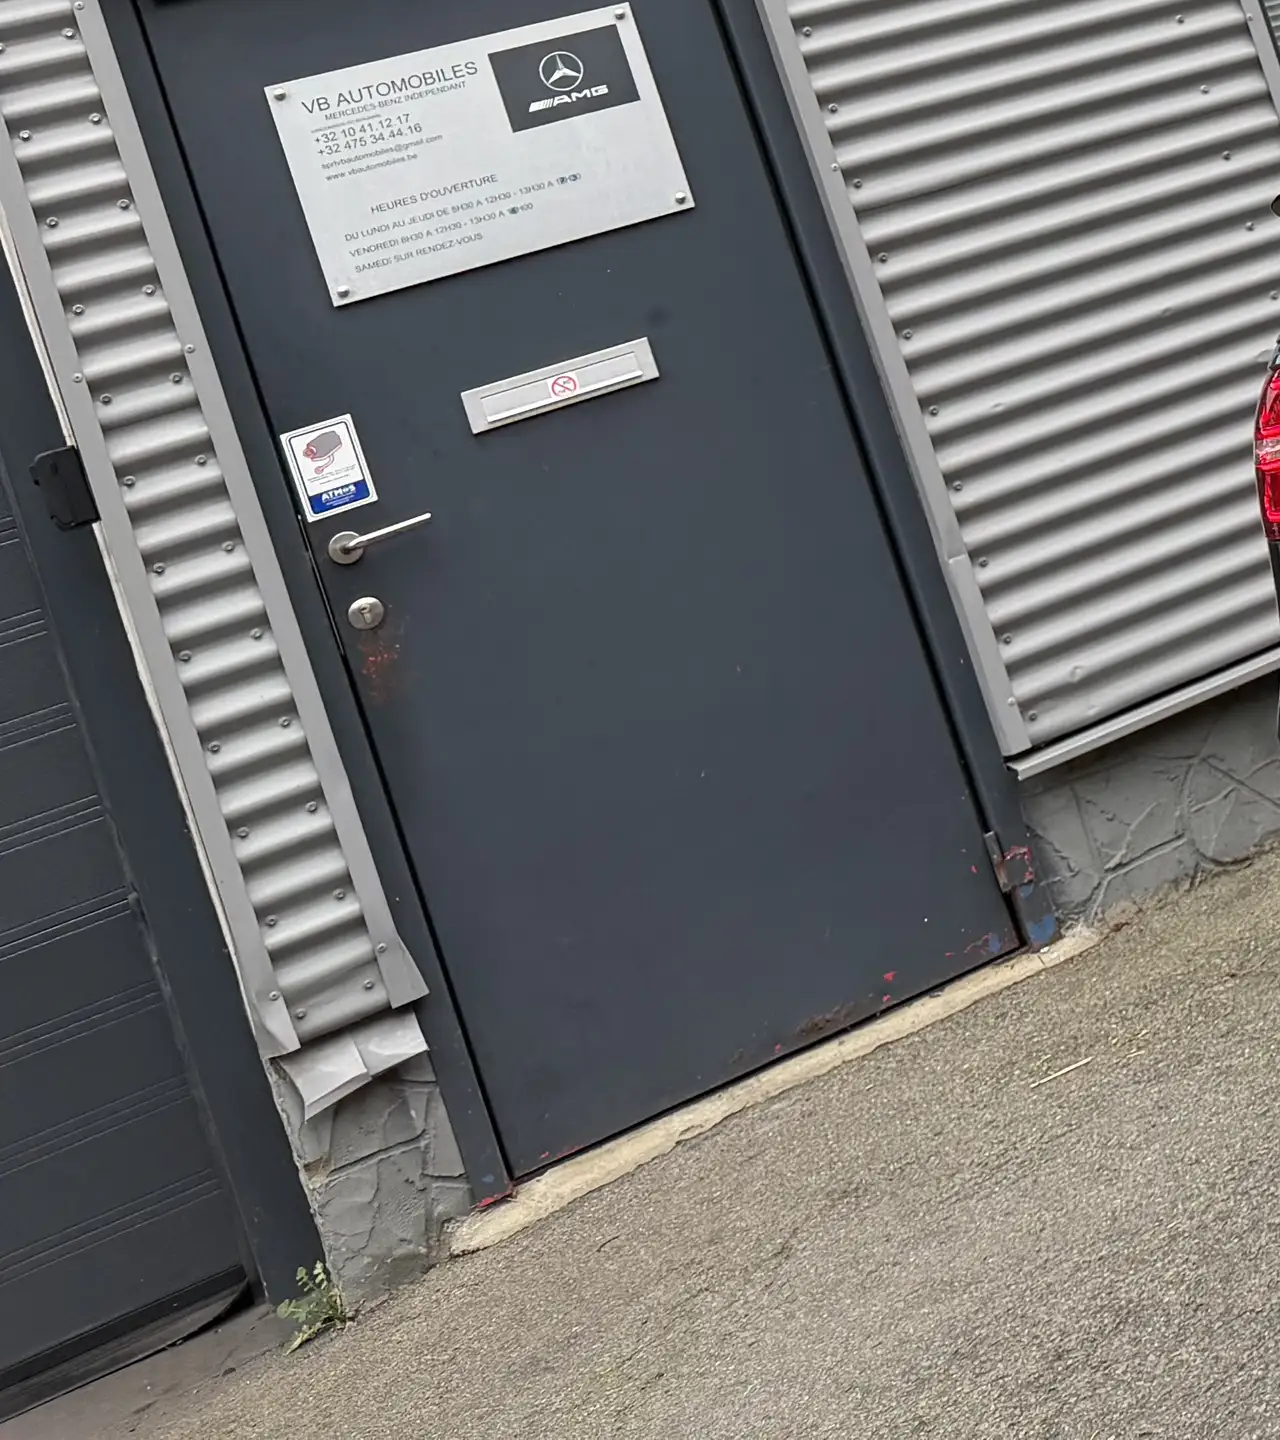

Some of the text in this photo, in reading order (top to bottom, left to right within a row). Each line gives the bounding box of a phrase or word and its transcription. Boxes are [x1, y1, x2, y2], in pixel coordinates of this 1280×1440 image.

[301, 61, 478, 114] VB AUTOMOBILES
[315, 131, 338, 143] +32
[340, 126, 356, 138] 10
[359, 113, 410, 133] 41.12.17
[325, 97, 403, 121] MERCEDES-BENZ
[318, 143, 341, 155] +32
[344, 136, 367, 150] 475
[369, 123, 422, 144] 34.44.16
[344, 231, 359, 242] DU
[361, 223, 390, 238] LUNDI
[391, 219, 406, 231] AU
[407, 211, 435, 226] JEUDI
[436, 207, 450, 218] DE
[476, 199, 483, 207] A
[547, 180, 554, 188] A
[370, 174, 498, 214] HEURES D'OUVERTURE
[349, 239, 399, 258] VENDREDI
[425, 229, 433, 237] A
[498, 210, 505, 218] A
[355, 232, 484, 273] SAMEDI SUR RENDEZ-VOUS
